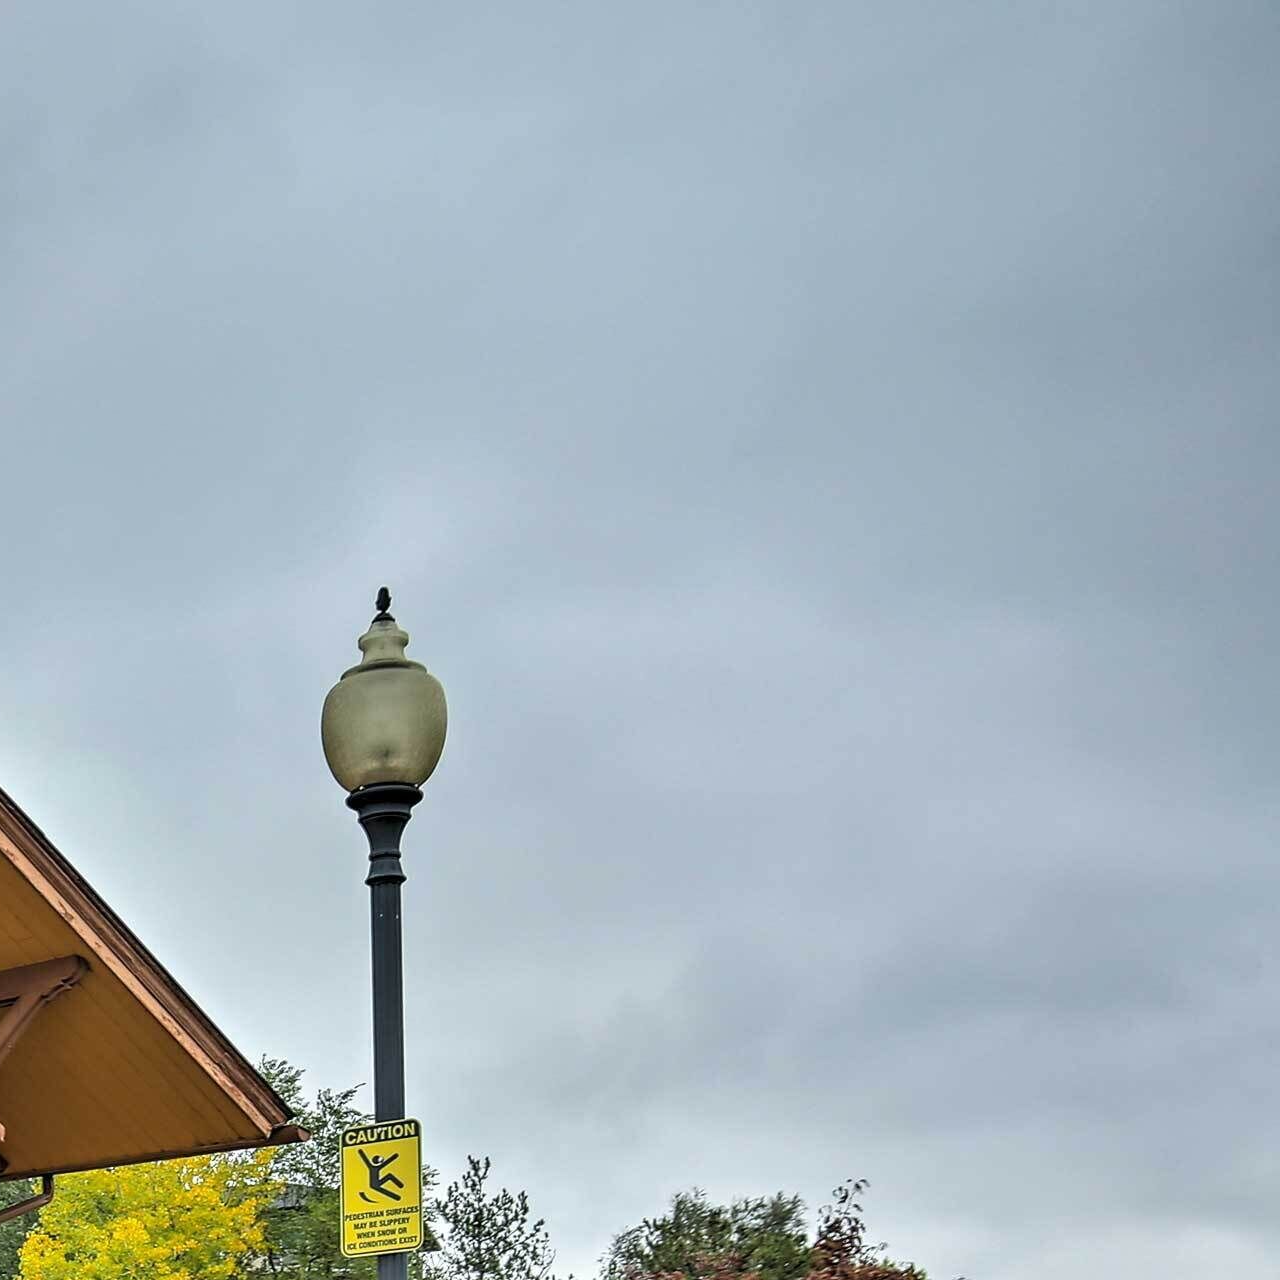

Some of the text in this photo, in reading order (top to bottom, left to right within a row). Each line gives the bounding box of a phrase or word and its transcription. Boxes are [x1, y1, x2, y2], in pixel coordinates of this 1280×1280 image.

[345, 1123, 416, 1145] CAUTION
[344, 1205, 419, 1221] PEDESTRIAN SURFACES
[353, 1217, 410, 1230] MAY BE SLIPPERY
[356, 1231, 376, 1239] WHEN
[377, 1228, 397, 1237] SNOW
[358, 1238, 397, 1248] CONDITIONS
[399, 1235, 417, 1244] EXIST
